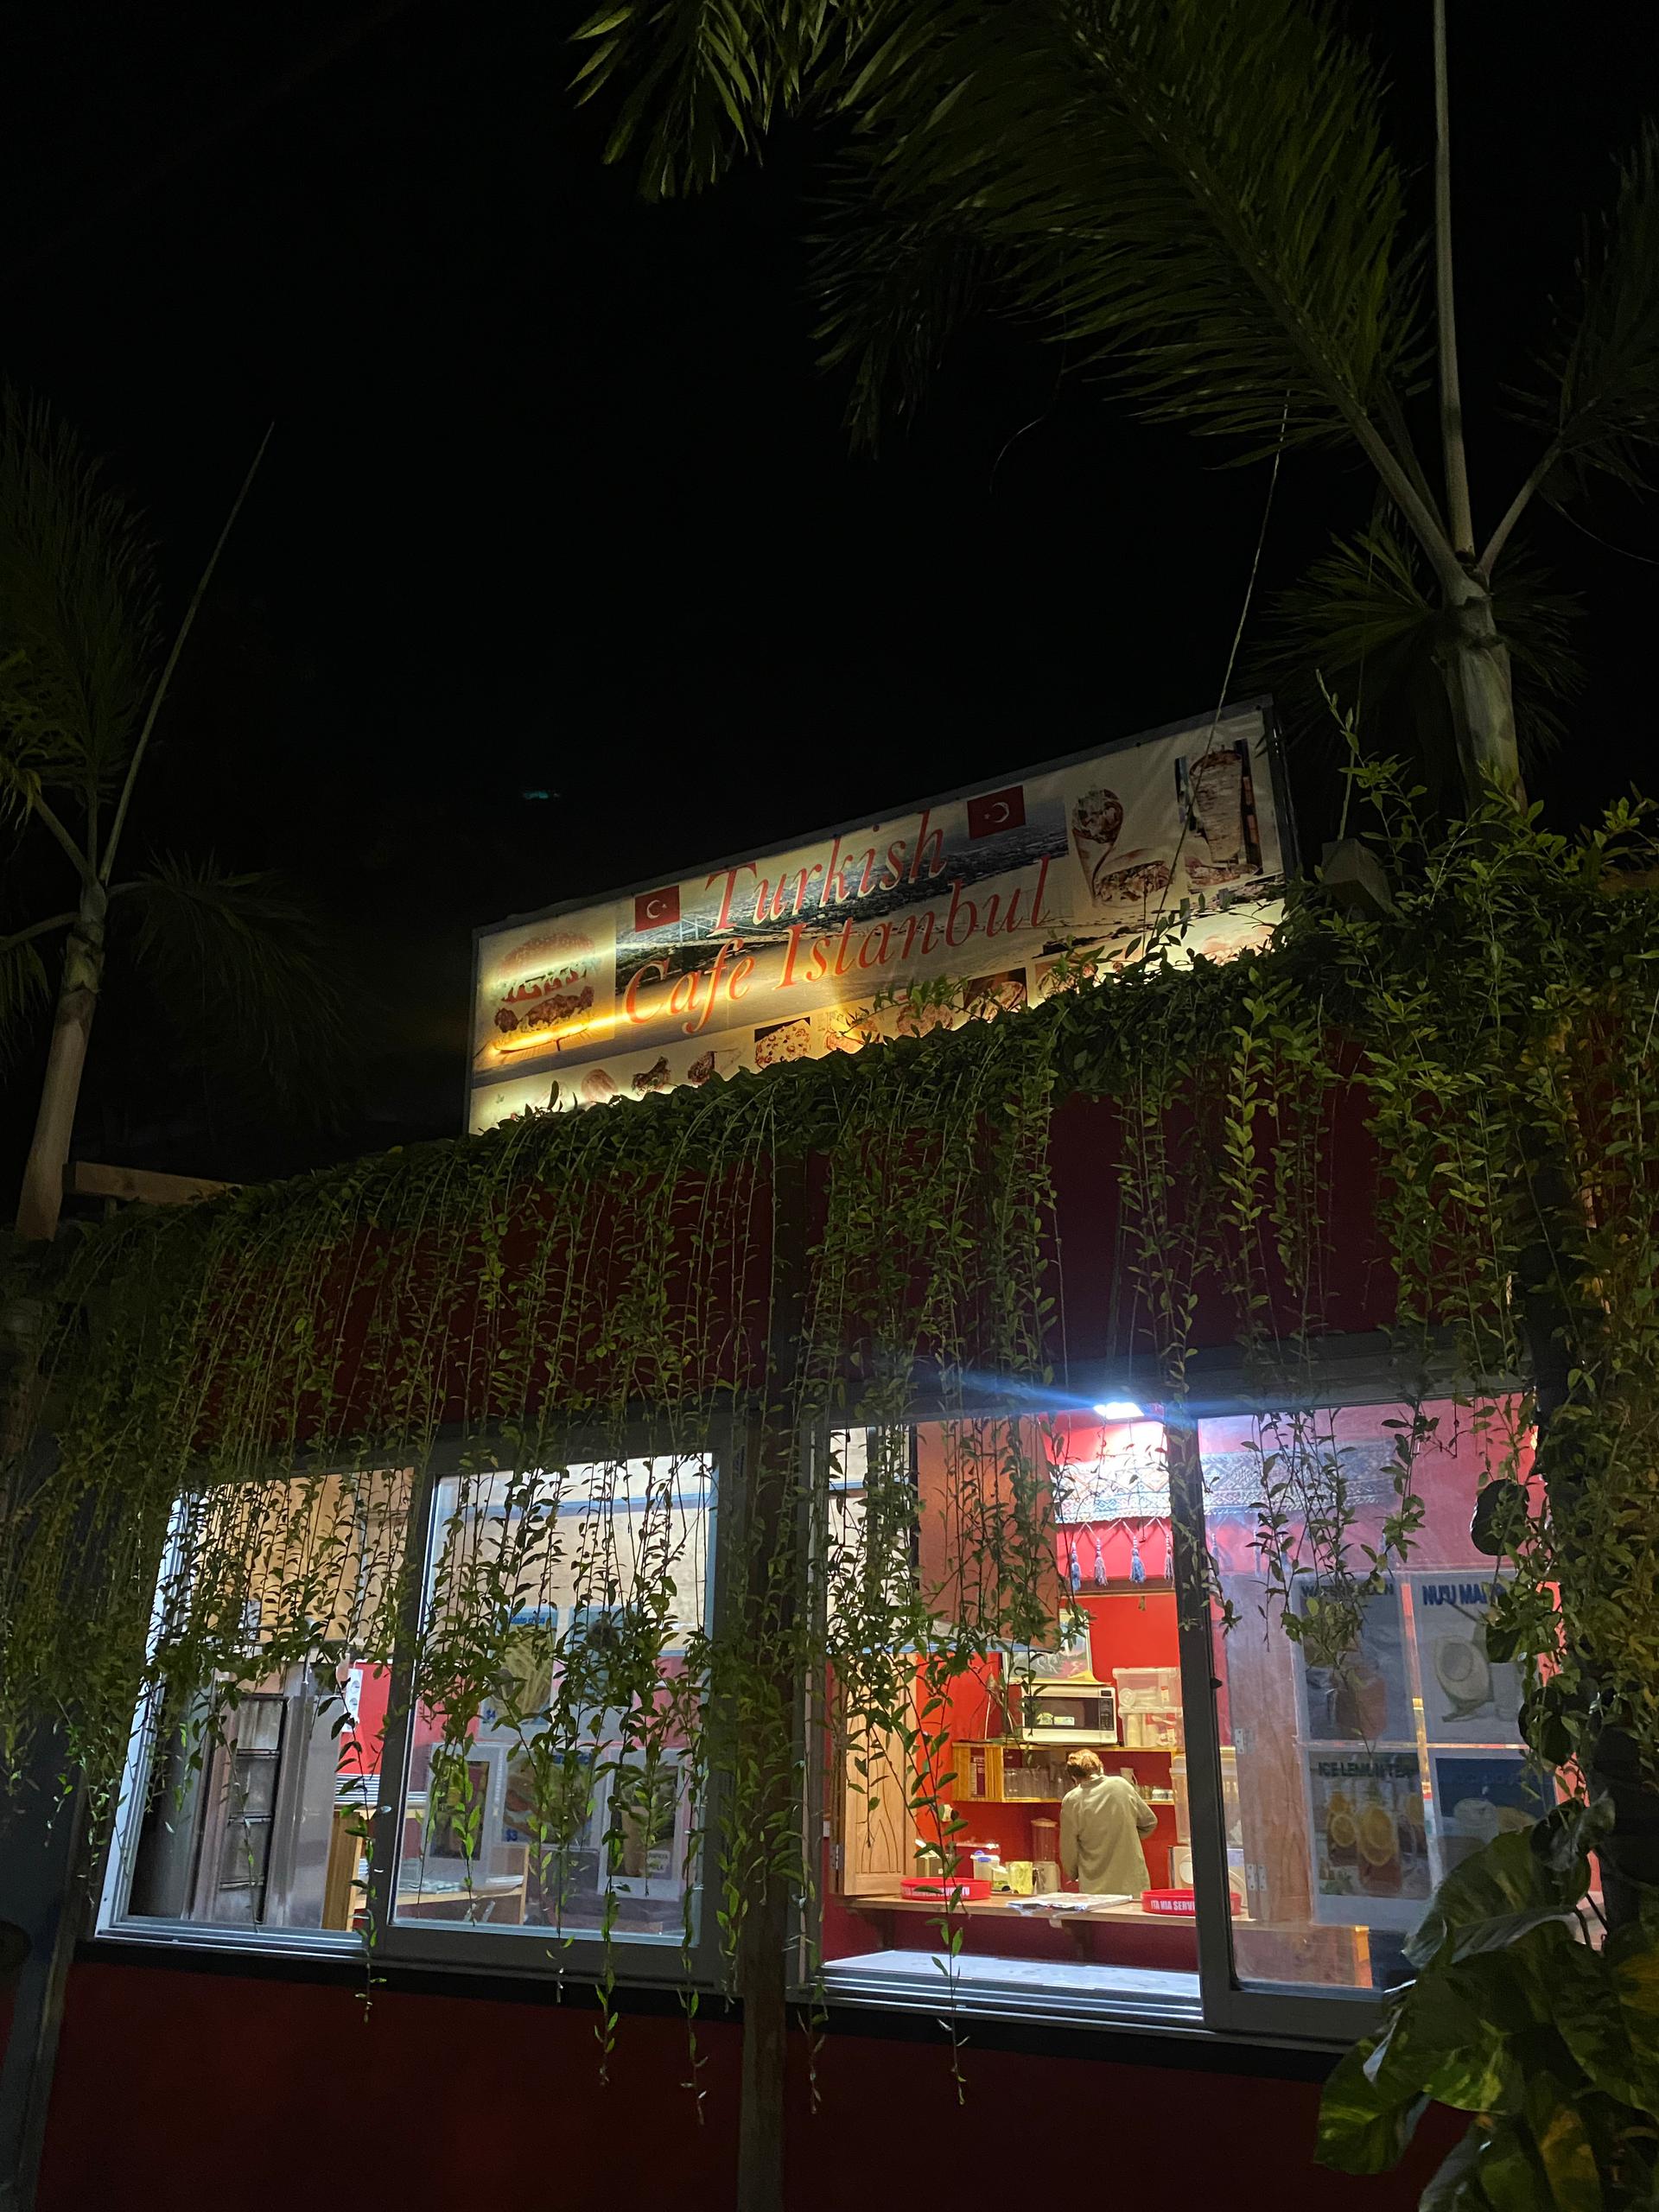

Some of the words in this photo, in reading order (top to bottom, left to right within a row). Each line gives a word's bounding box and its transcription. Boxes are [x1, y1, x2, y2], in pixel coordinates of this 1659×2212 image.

[622, 938, 755, 1034] Cafe
[772, 855, 1051, 990] Istanbul
[705, 808, 948, 938] Turkish
